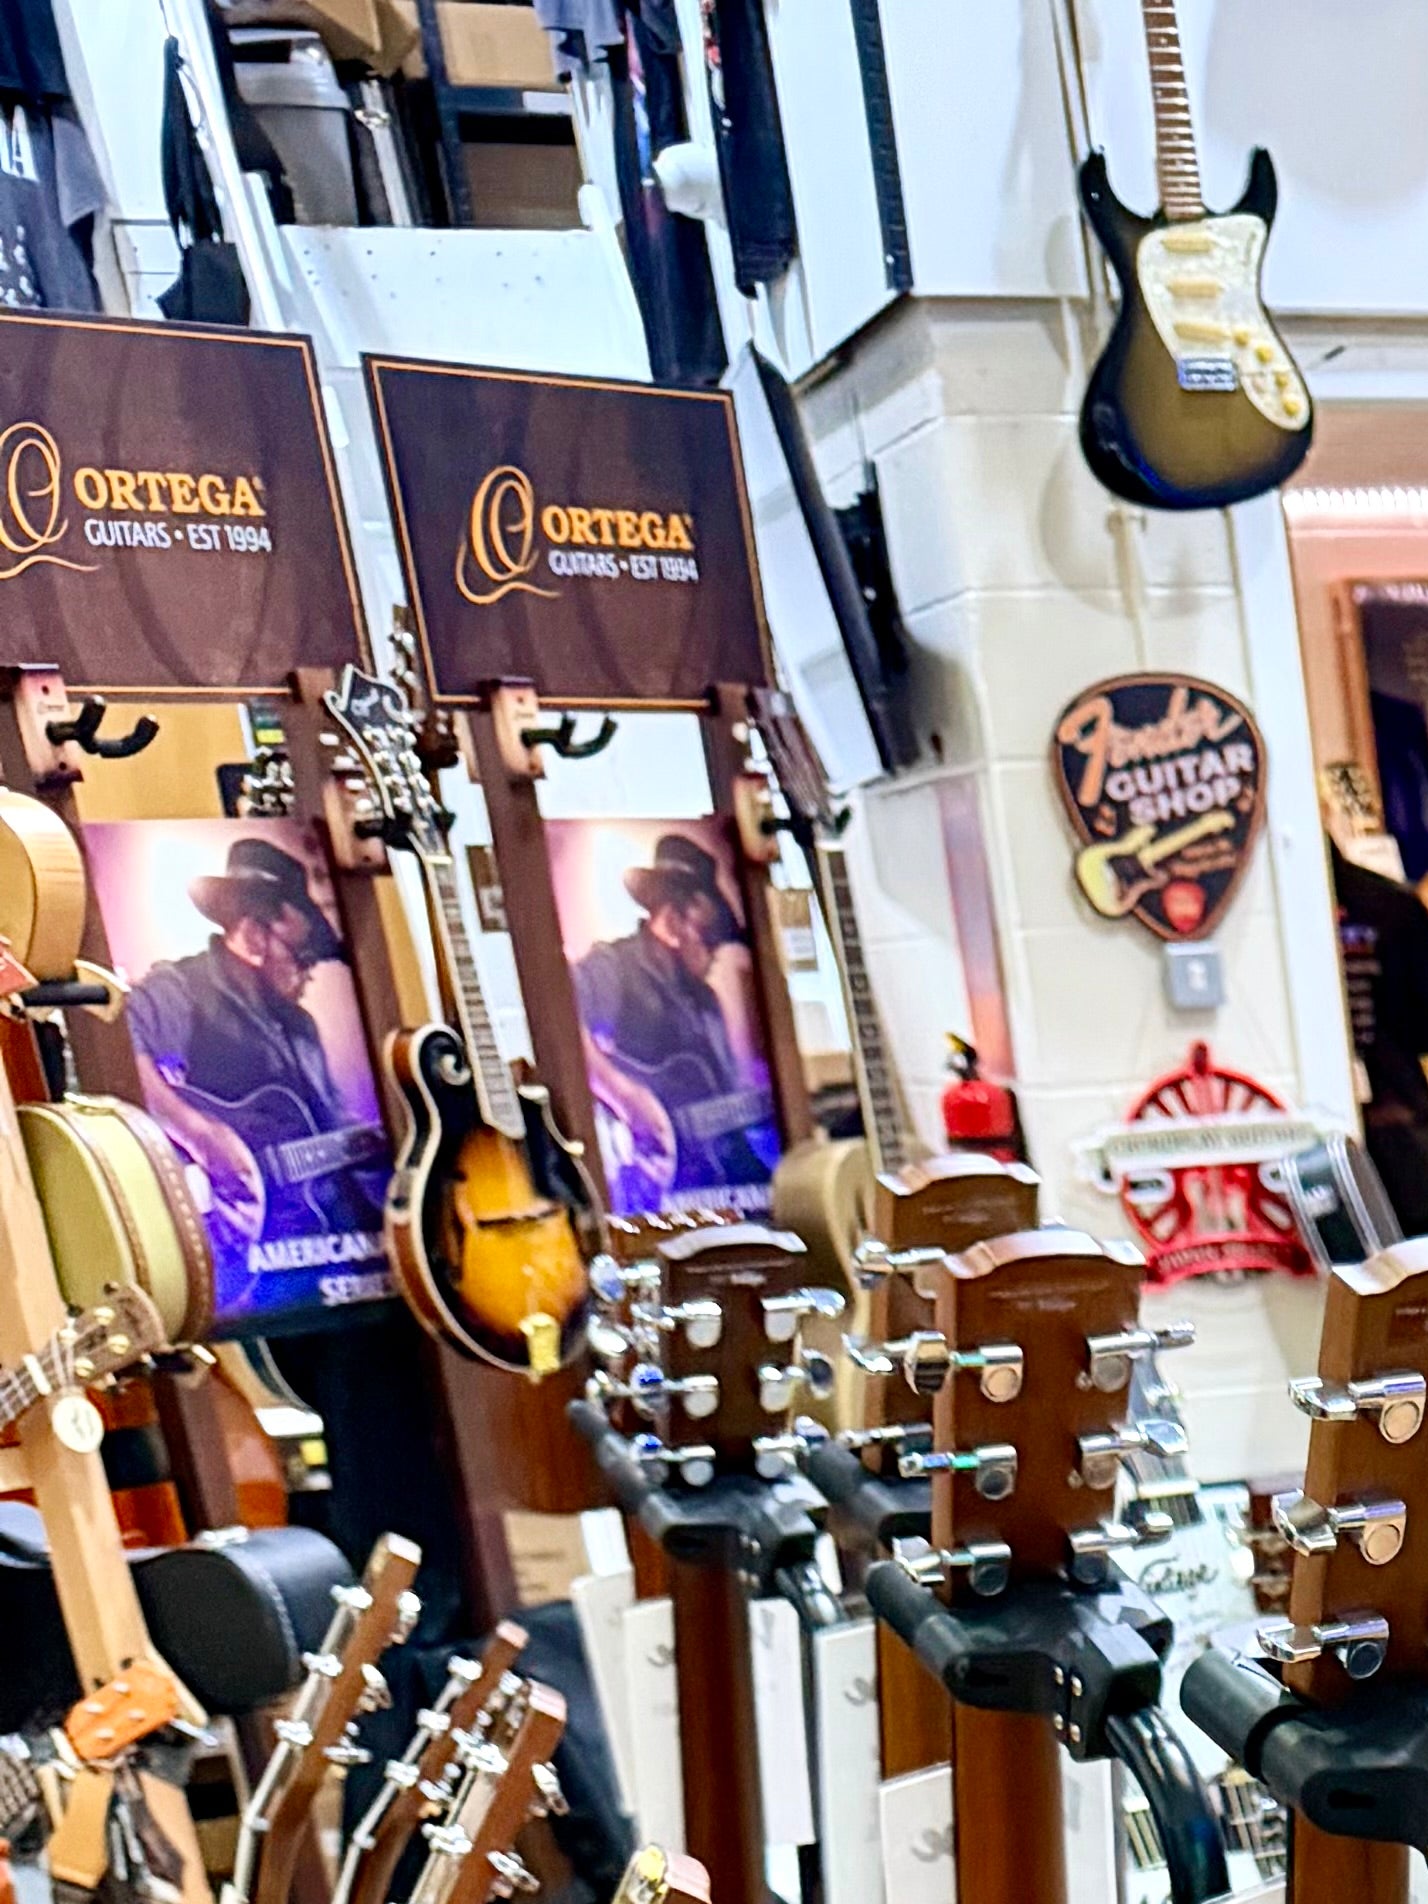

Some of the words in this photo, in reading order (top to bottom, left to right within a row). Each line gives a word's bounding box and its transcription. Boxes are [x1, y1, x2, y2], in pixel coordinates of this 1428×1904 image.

[75, 468, 265, 516] ORTEGA
[84, 519, 170, 549] GUITARS
[187, 522, 221, 552] EST
[224, 524, 272, 553] 1994
[541, 506, 693, 550] ORTEGA
[1105, 743, 1252, 801] GUITAR
[1129, 776, 1241, 825] SHOP
